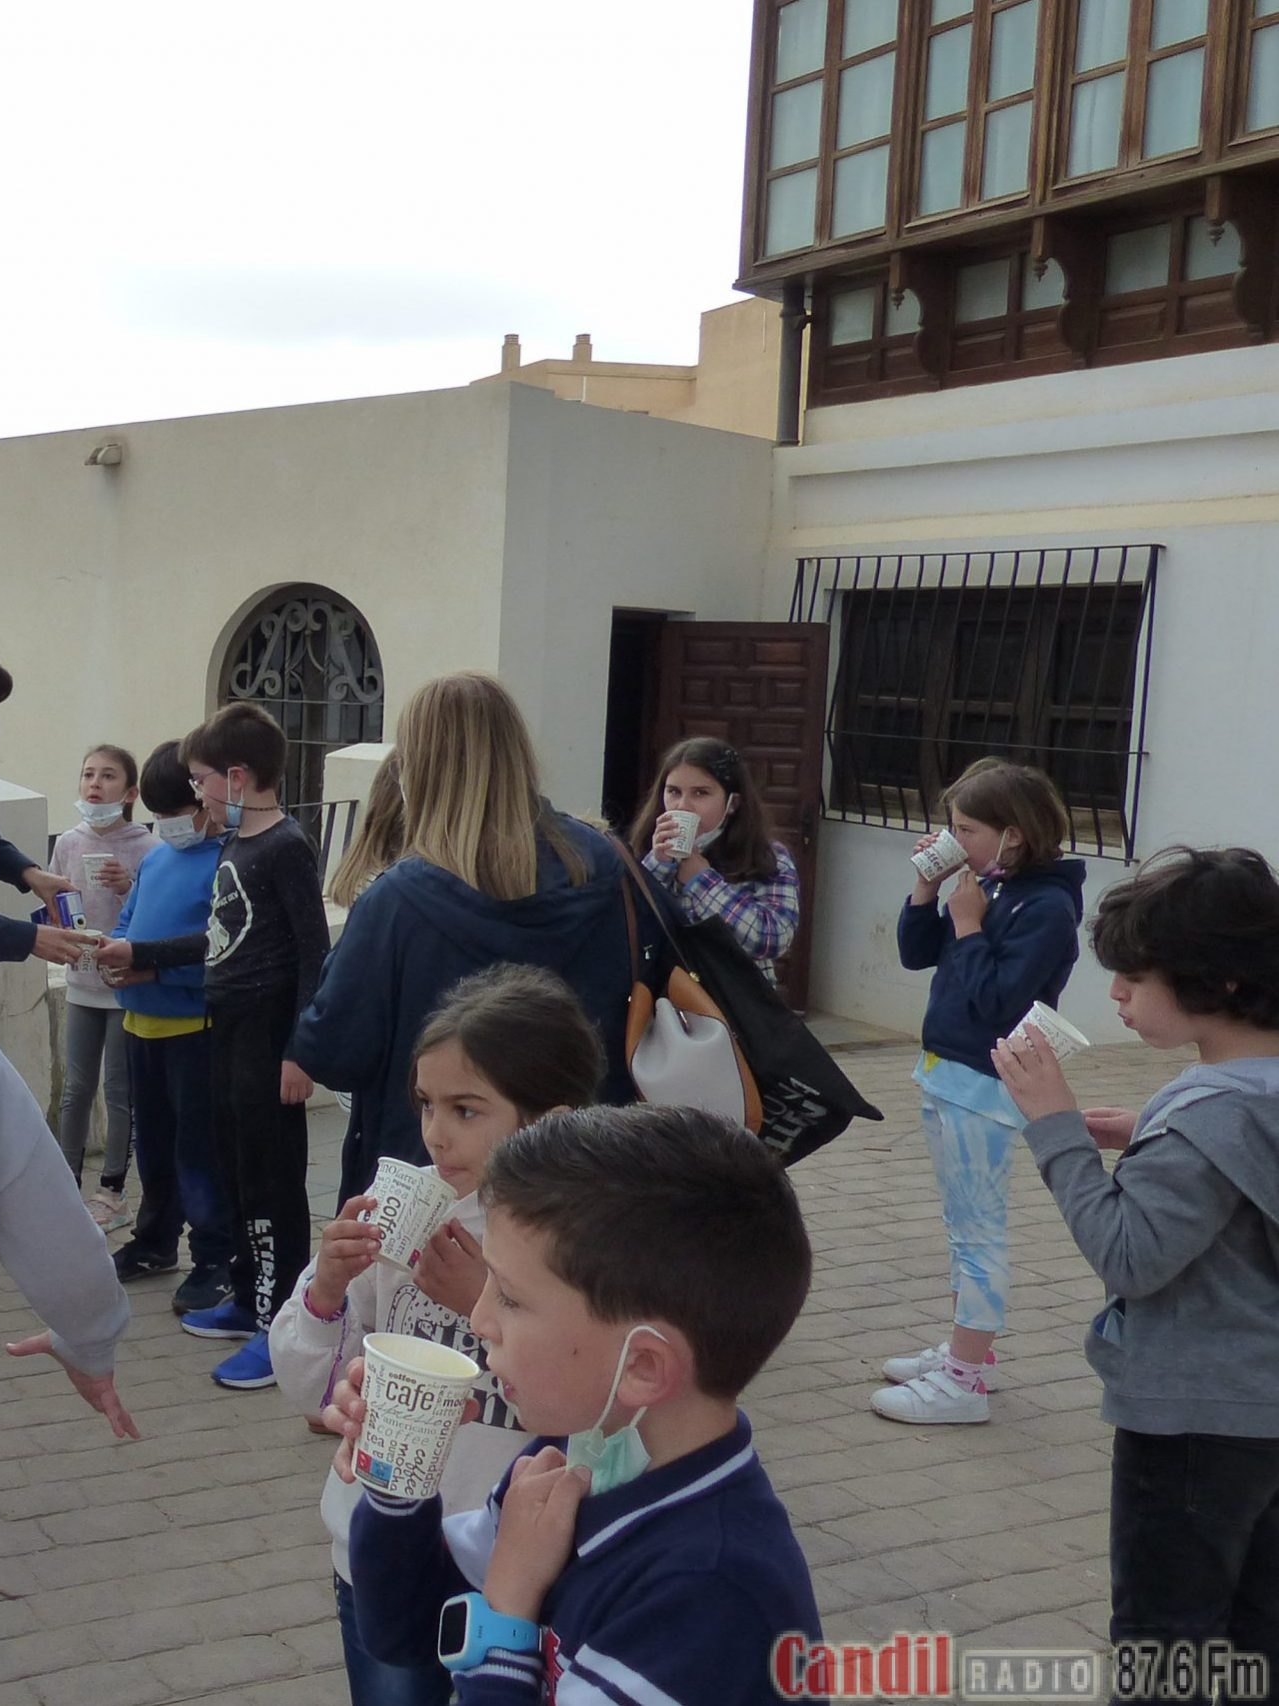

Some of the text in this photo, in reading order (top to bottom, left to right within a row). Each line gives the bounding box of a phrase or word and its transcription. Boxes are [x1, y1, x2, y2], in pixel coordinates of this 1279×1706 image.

[923, 847, 944, 872] offee
[377, 1196, 401, 1248] coffe
[388, 1371, 417, 1385] coffee
[385, 1380, 435, 1412] cafe
[366, 1431, 385, 1449] tea
[377, 1423, 431, 1447] coffee
[382, 1416, 437, 1436] americano
[389, 1443, 409, 1492] mocha
[404, 1448, 426, 1497] coffee
[420, 1420, 452, 1498] cappuccino
